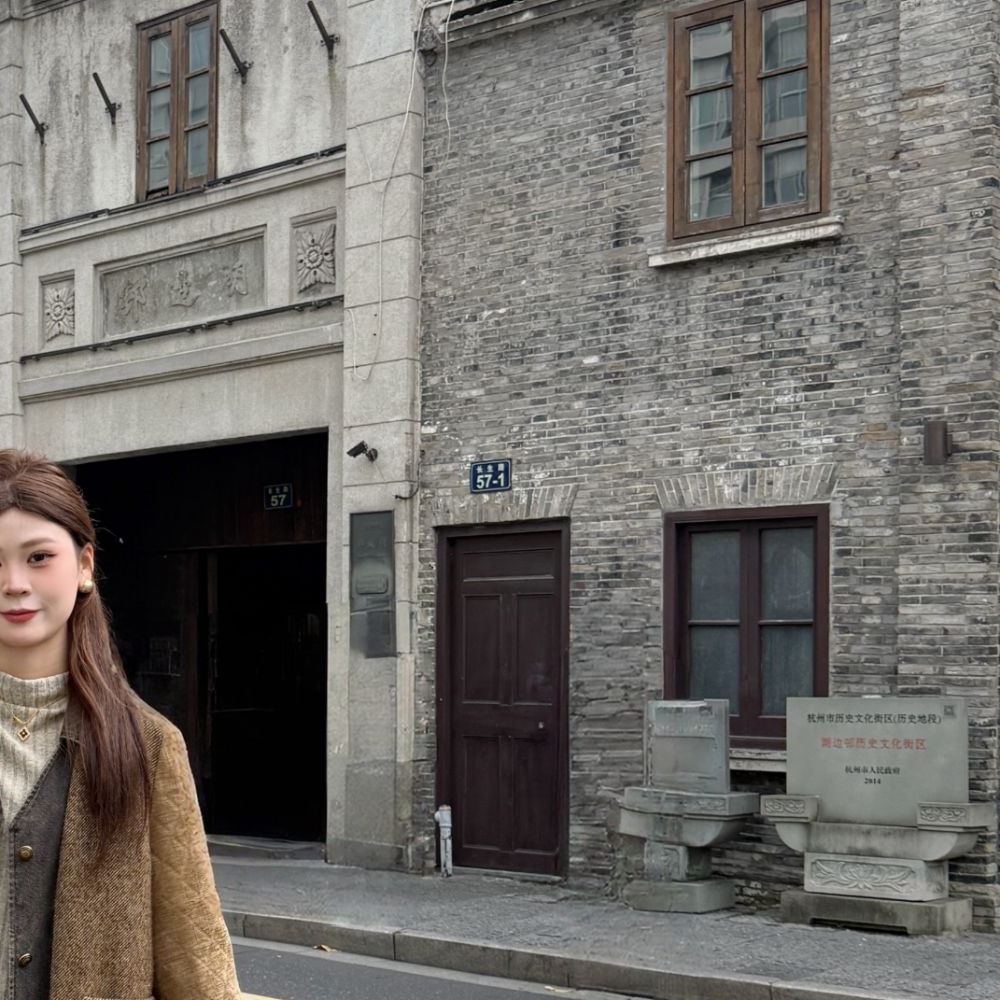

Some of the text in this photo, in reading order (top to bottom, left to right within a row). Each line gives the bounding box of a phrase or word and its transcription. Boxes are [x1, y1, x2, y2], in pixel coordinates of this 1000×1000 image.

[476, 472, 504, 489] 57-1
[271, 494, 286, 506] 57
[807, 713, 942, 724] 杭州市历史文化街区(历史地段)
